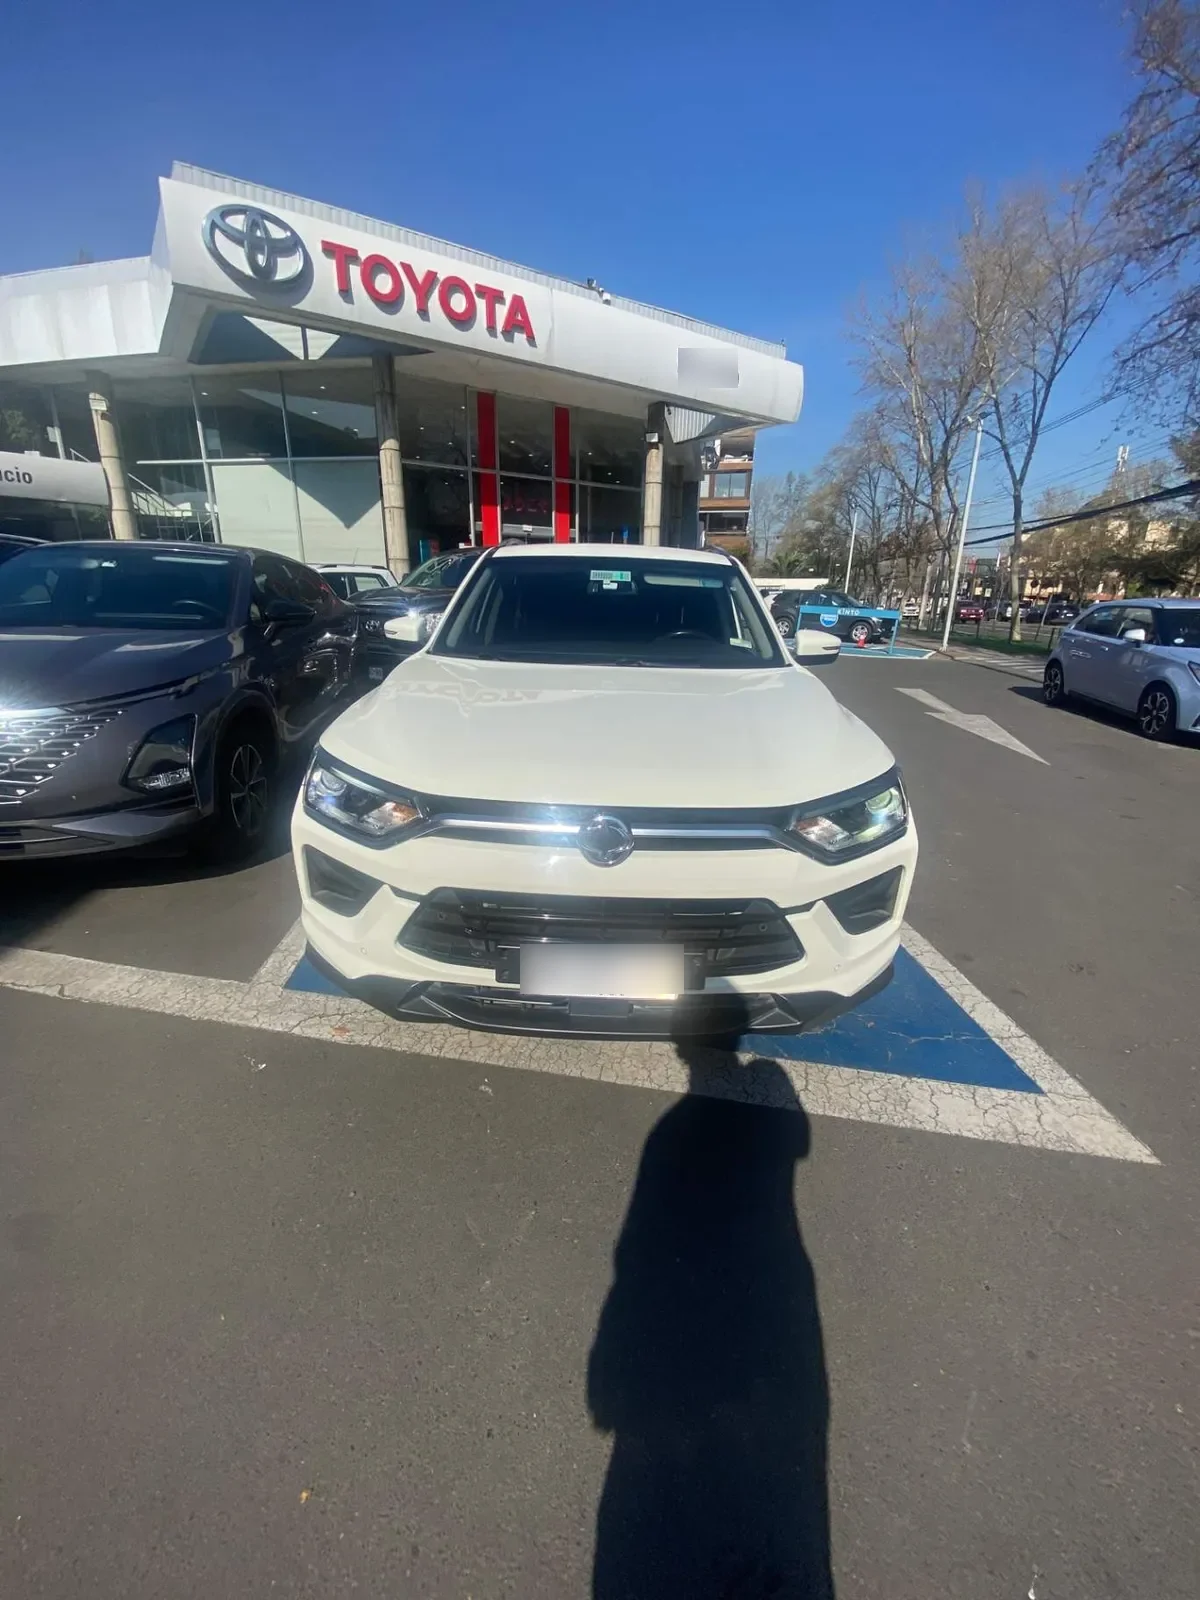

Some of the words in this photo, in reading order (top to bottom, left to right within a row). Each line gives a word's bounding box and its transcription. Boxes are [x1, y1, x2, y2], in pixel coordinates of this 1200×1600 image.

[321, 240, 535, 341] TOYOTA
[0, 466, 33, 484] cio
[837, 608, 860, 616] KINTO
